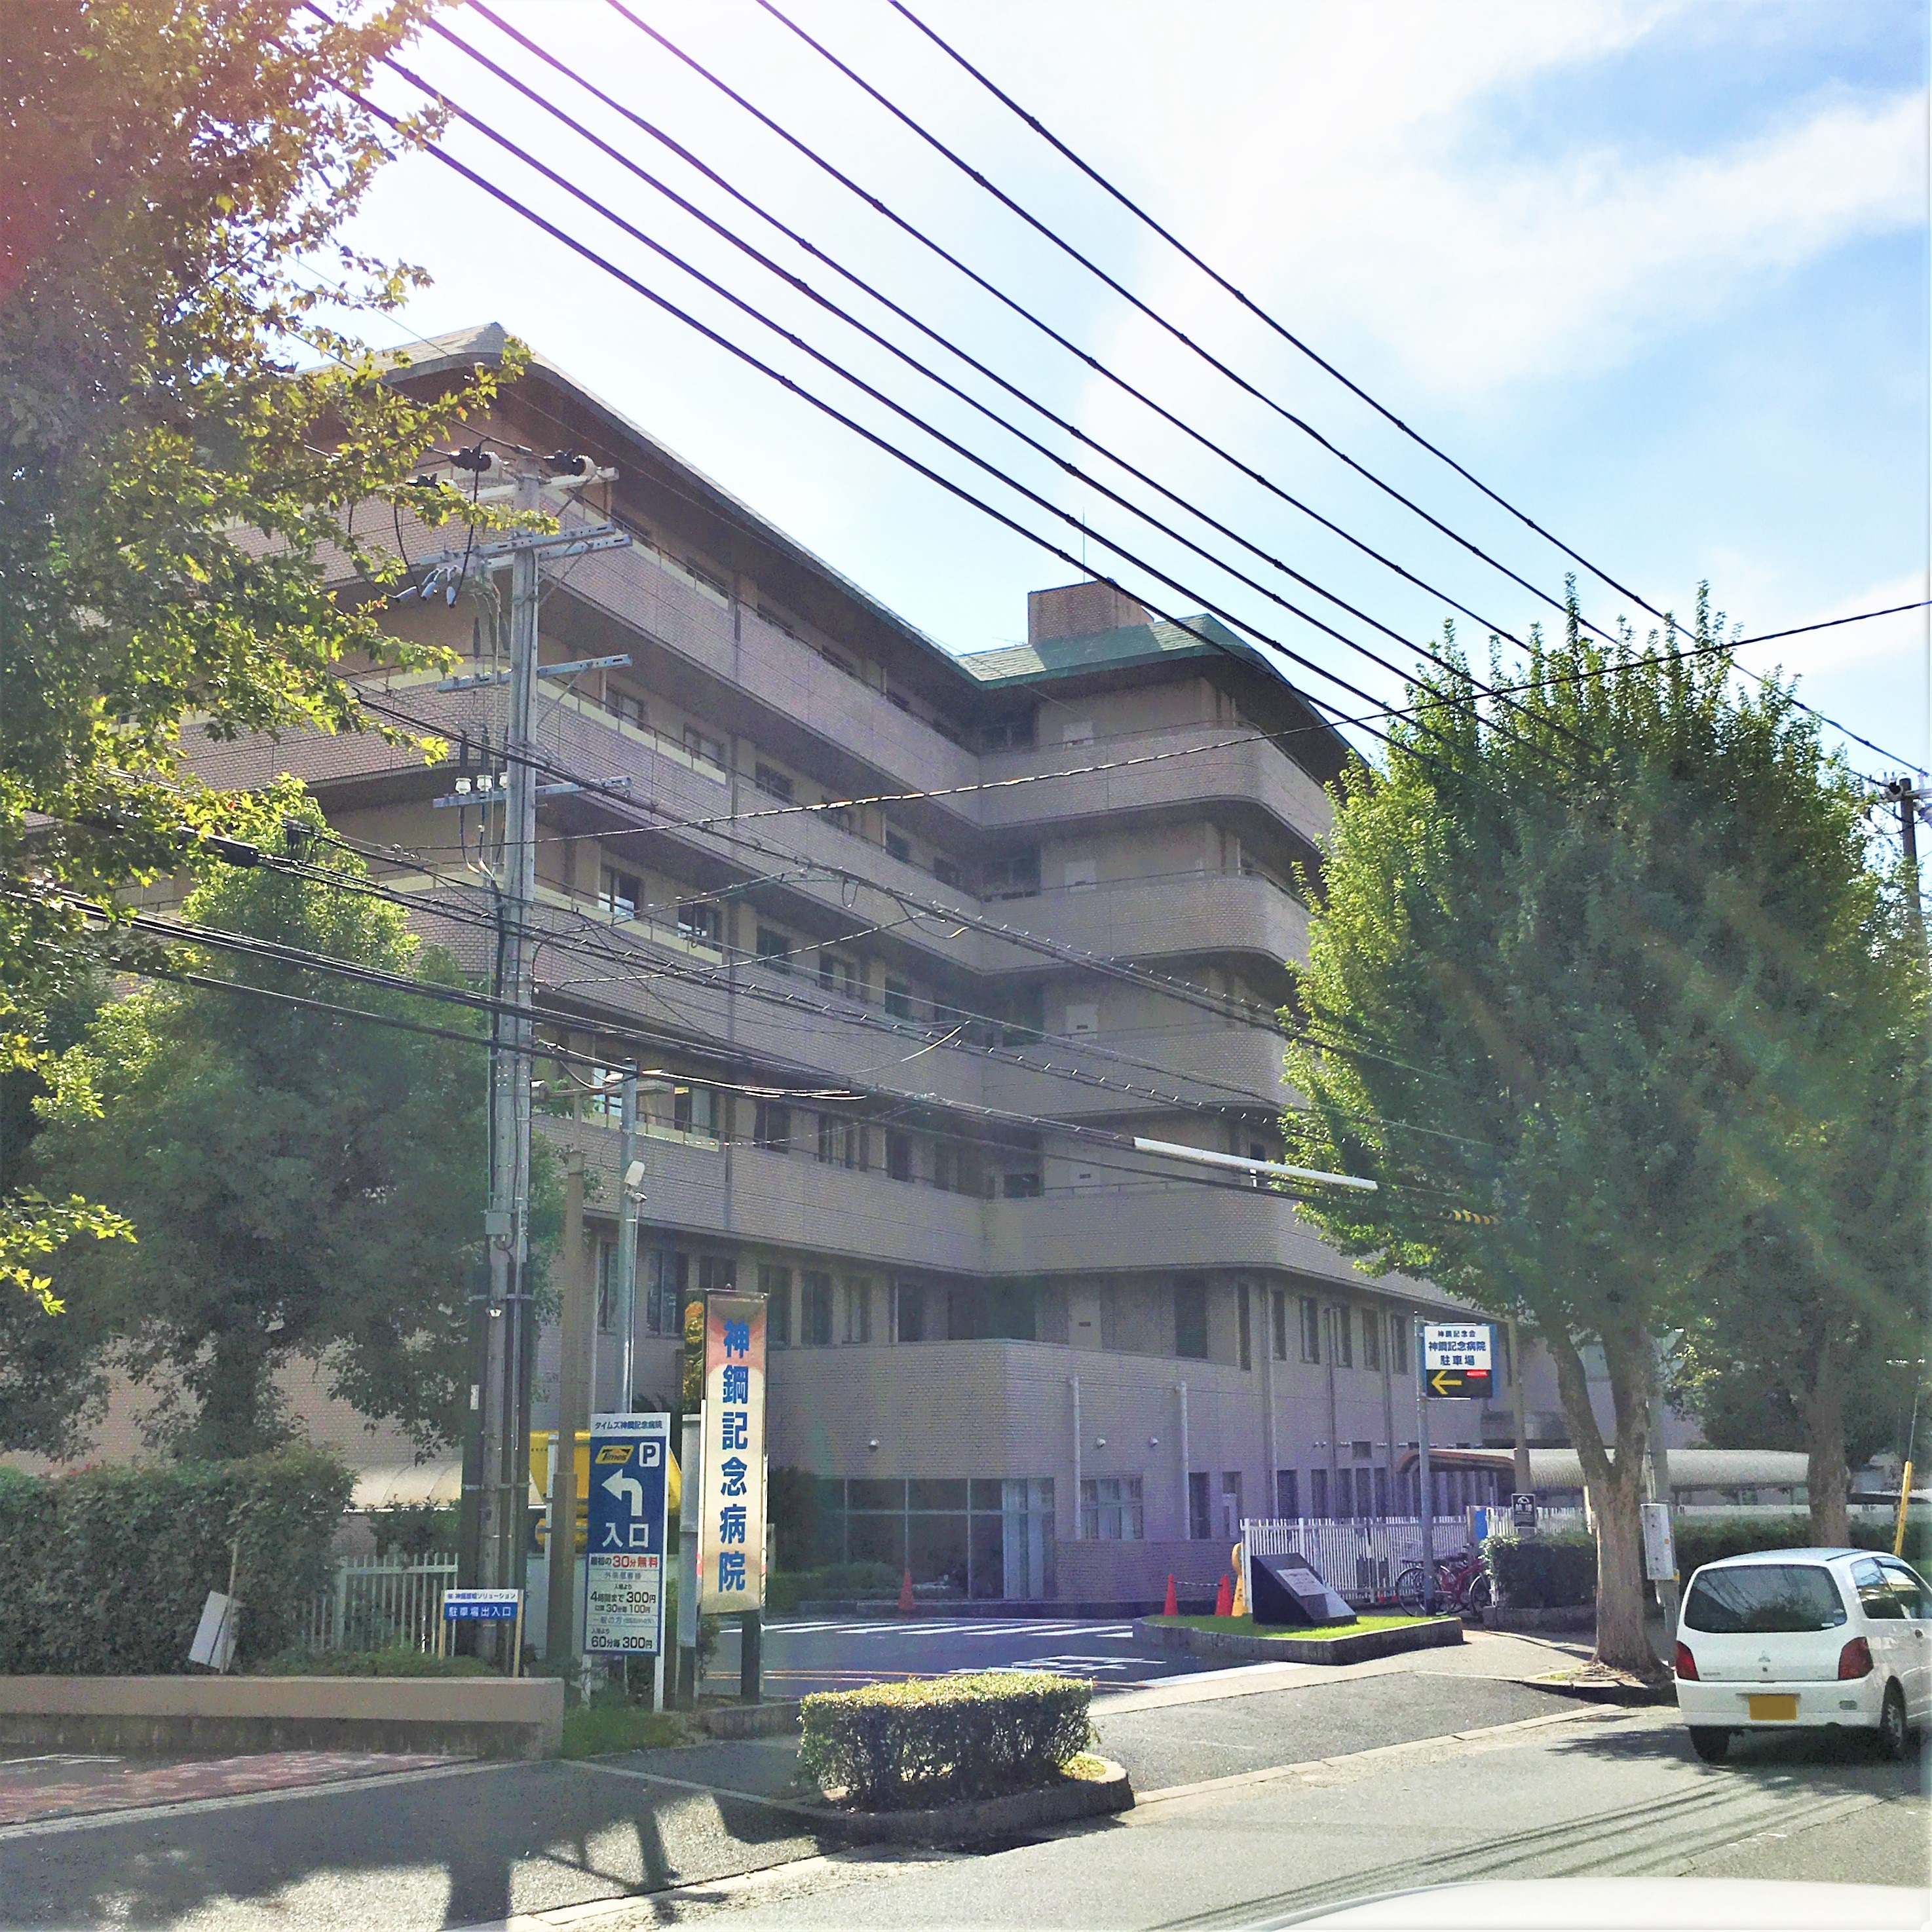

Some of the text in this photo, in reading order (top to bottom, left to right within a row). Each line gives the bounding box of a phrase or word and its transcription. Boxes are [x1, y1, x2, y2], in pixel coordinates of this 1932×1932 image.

[1428, 1341, 1486, 1352] 神鋼記念病院
[1440, 1355, 1475, 1365] 駐車場
[643, 1445, 656, 1464] P
[719, 1319, 749, 1593] 神鋼記念病院
[602, 1523, 649, 1547] 入口
[449, 1606, 511, 1617] 駐車場出入口
